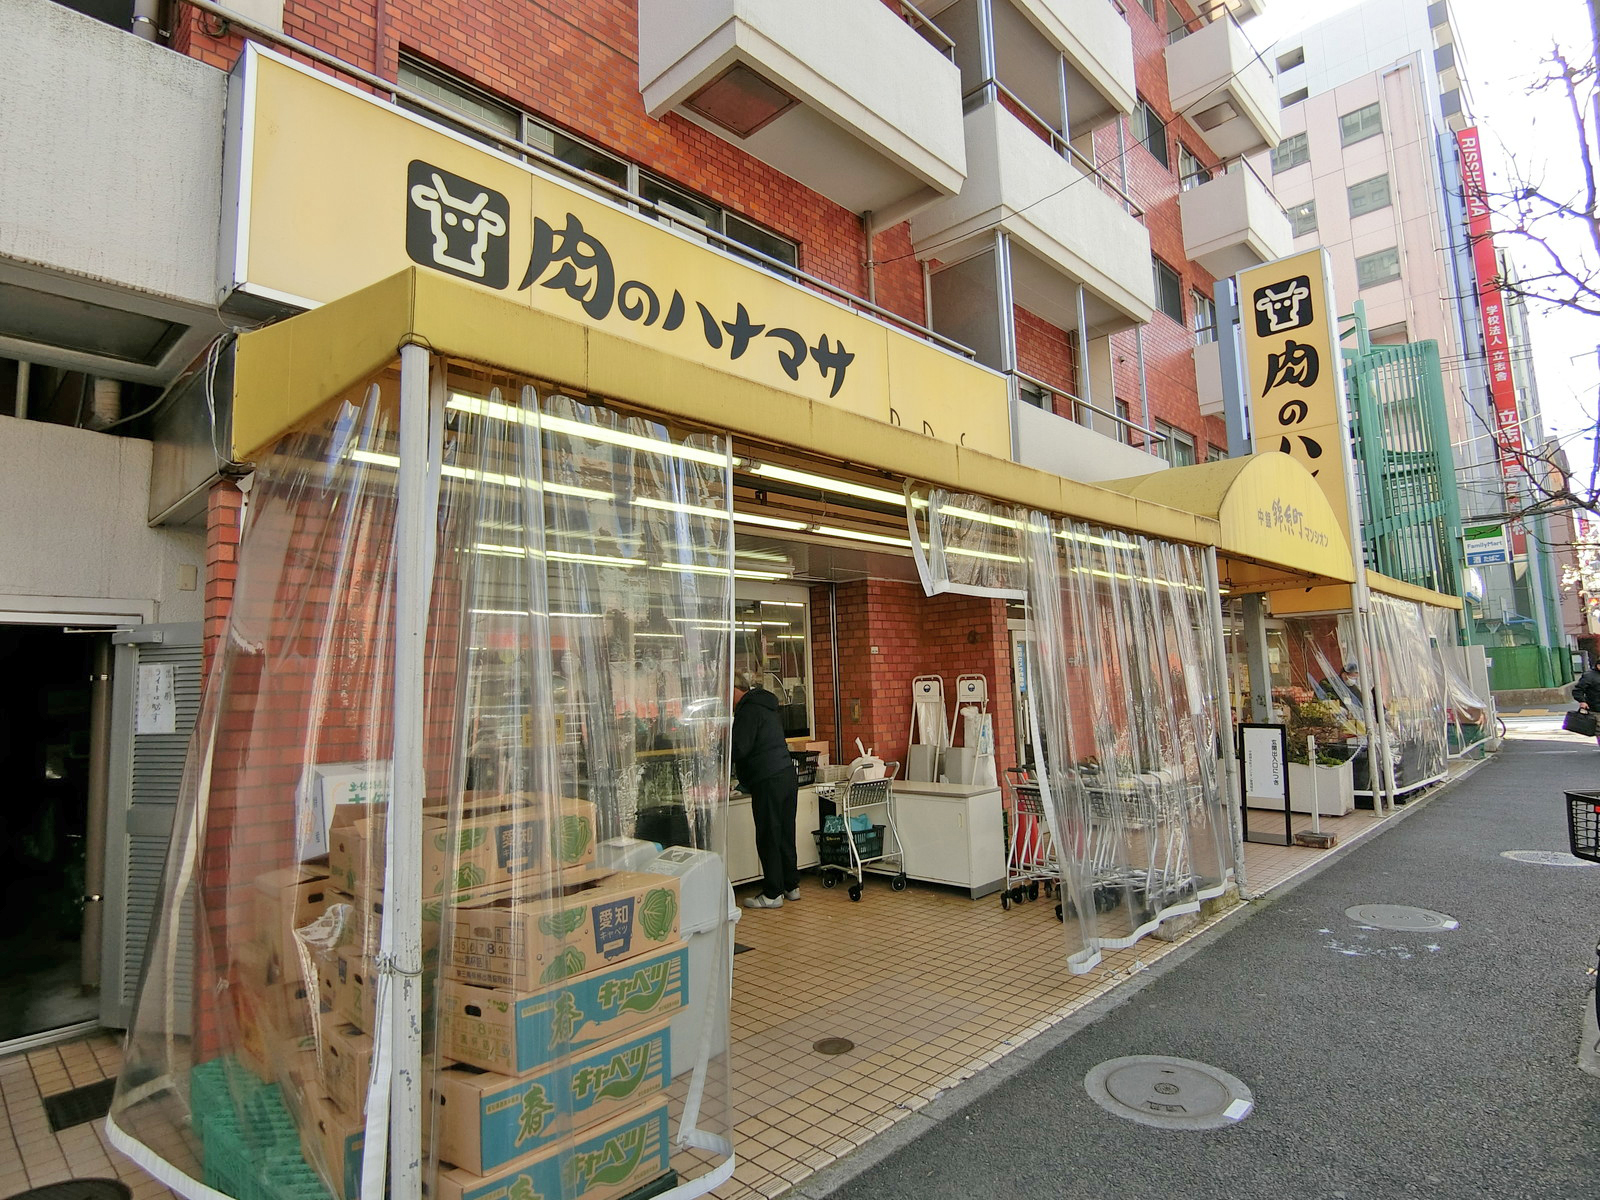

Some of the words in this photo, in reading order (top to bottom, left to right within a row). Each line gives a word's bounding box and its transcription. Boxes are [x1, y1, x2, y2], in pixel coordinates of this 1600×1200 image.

[518, 212, 856, 399] 肉のハナマサ
[1261, 339, 1323, 478] 肉のハ
[1467, 541, 1502, 549] FamilyMart
[599, 904, 629, 931] 愛知
[599, 925, 628, 941] キャベツ
[598, 958, 672, 1016] キャベツ
[548, 990, 584, 1051] 春
[571, 1040, 652, 1105] キャベツ
[515, 1082, 555, 1148] 春
